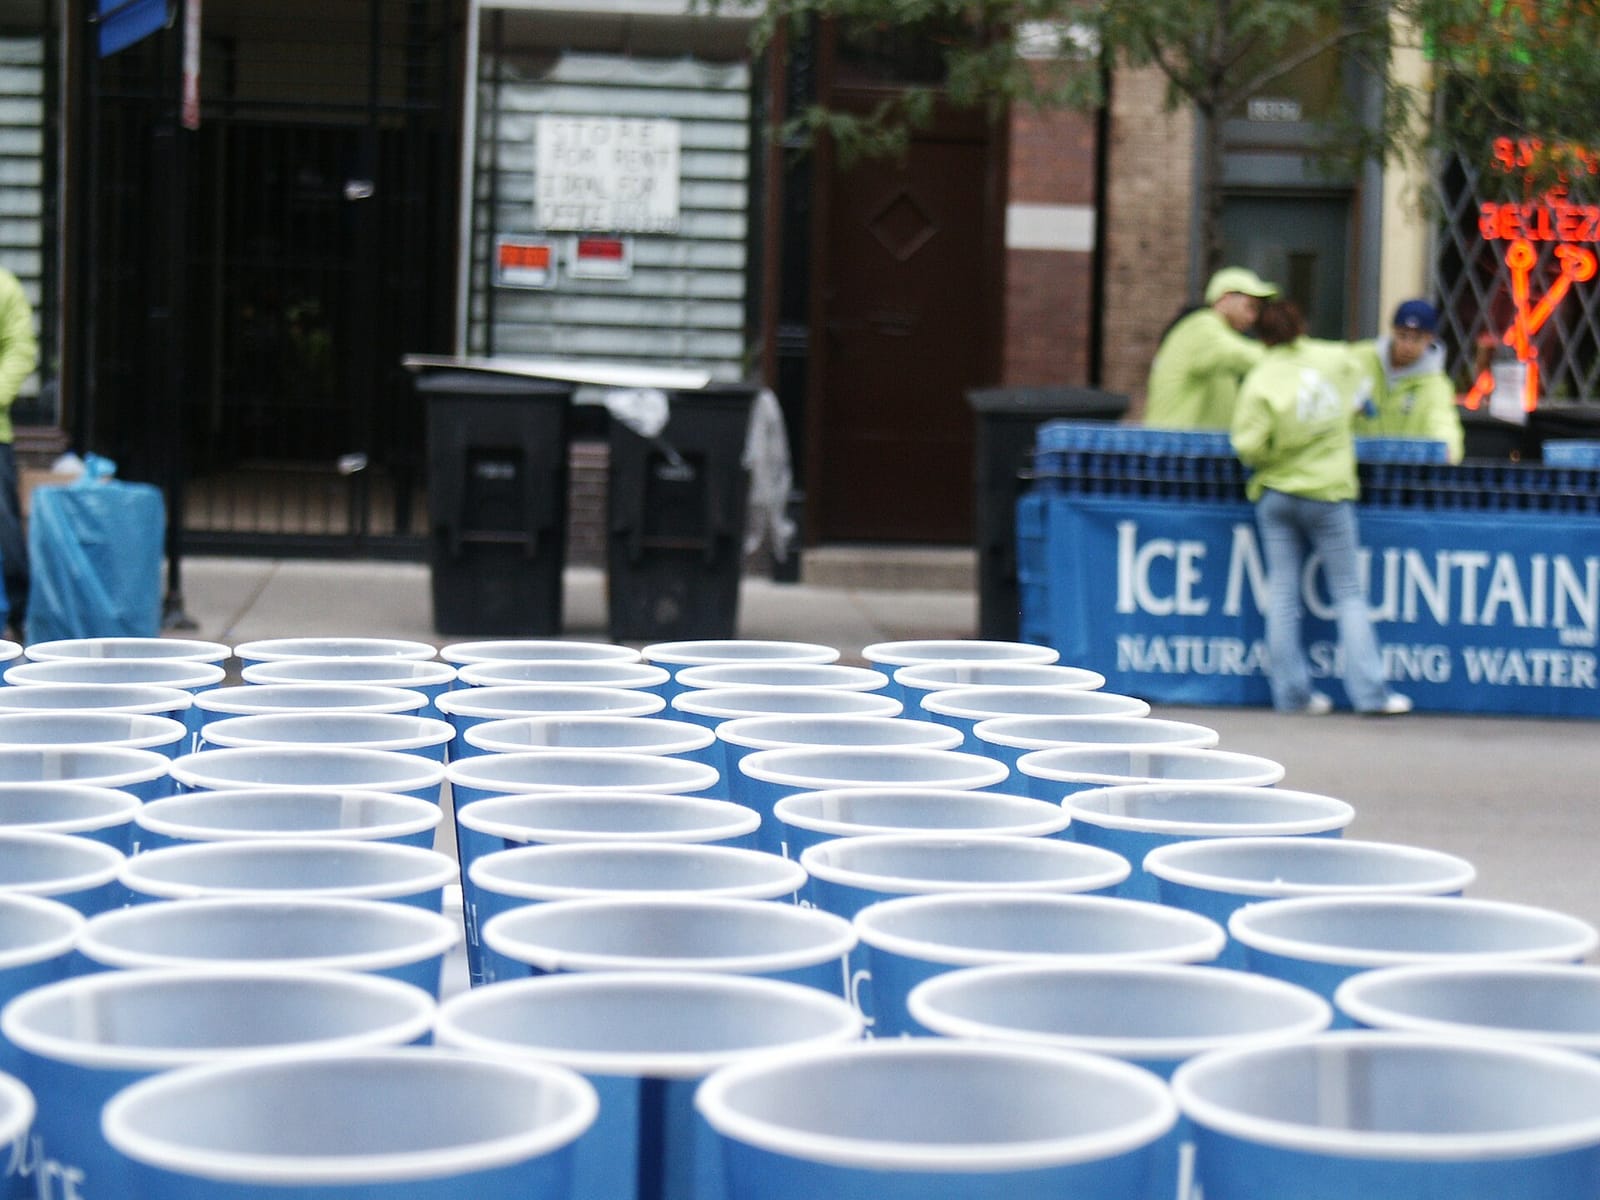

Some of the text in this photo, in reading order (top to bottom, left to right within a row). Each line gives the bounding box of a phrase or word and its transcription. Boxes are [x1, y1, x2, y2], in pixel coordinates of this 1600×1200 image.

[1478, 202, 1600, 241] BELLEZ
[1116, 520, 1210, 616] ICE
[1116, 634, 1598, 689] NATURA SING WATER
